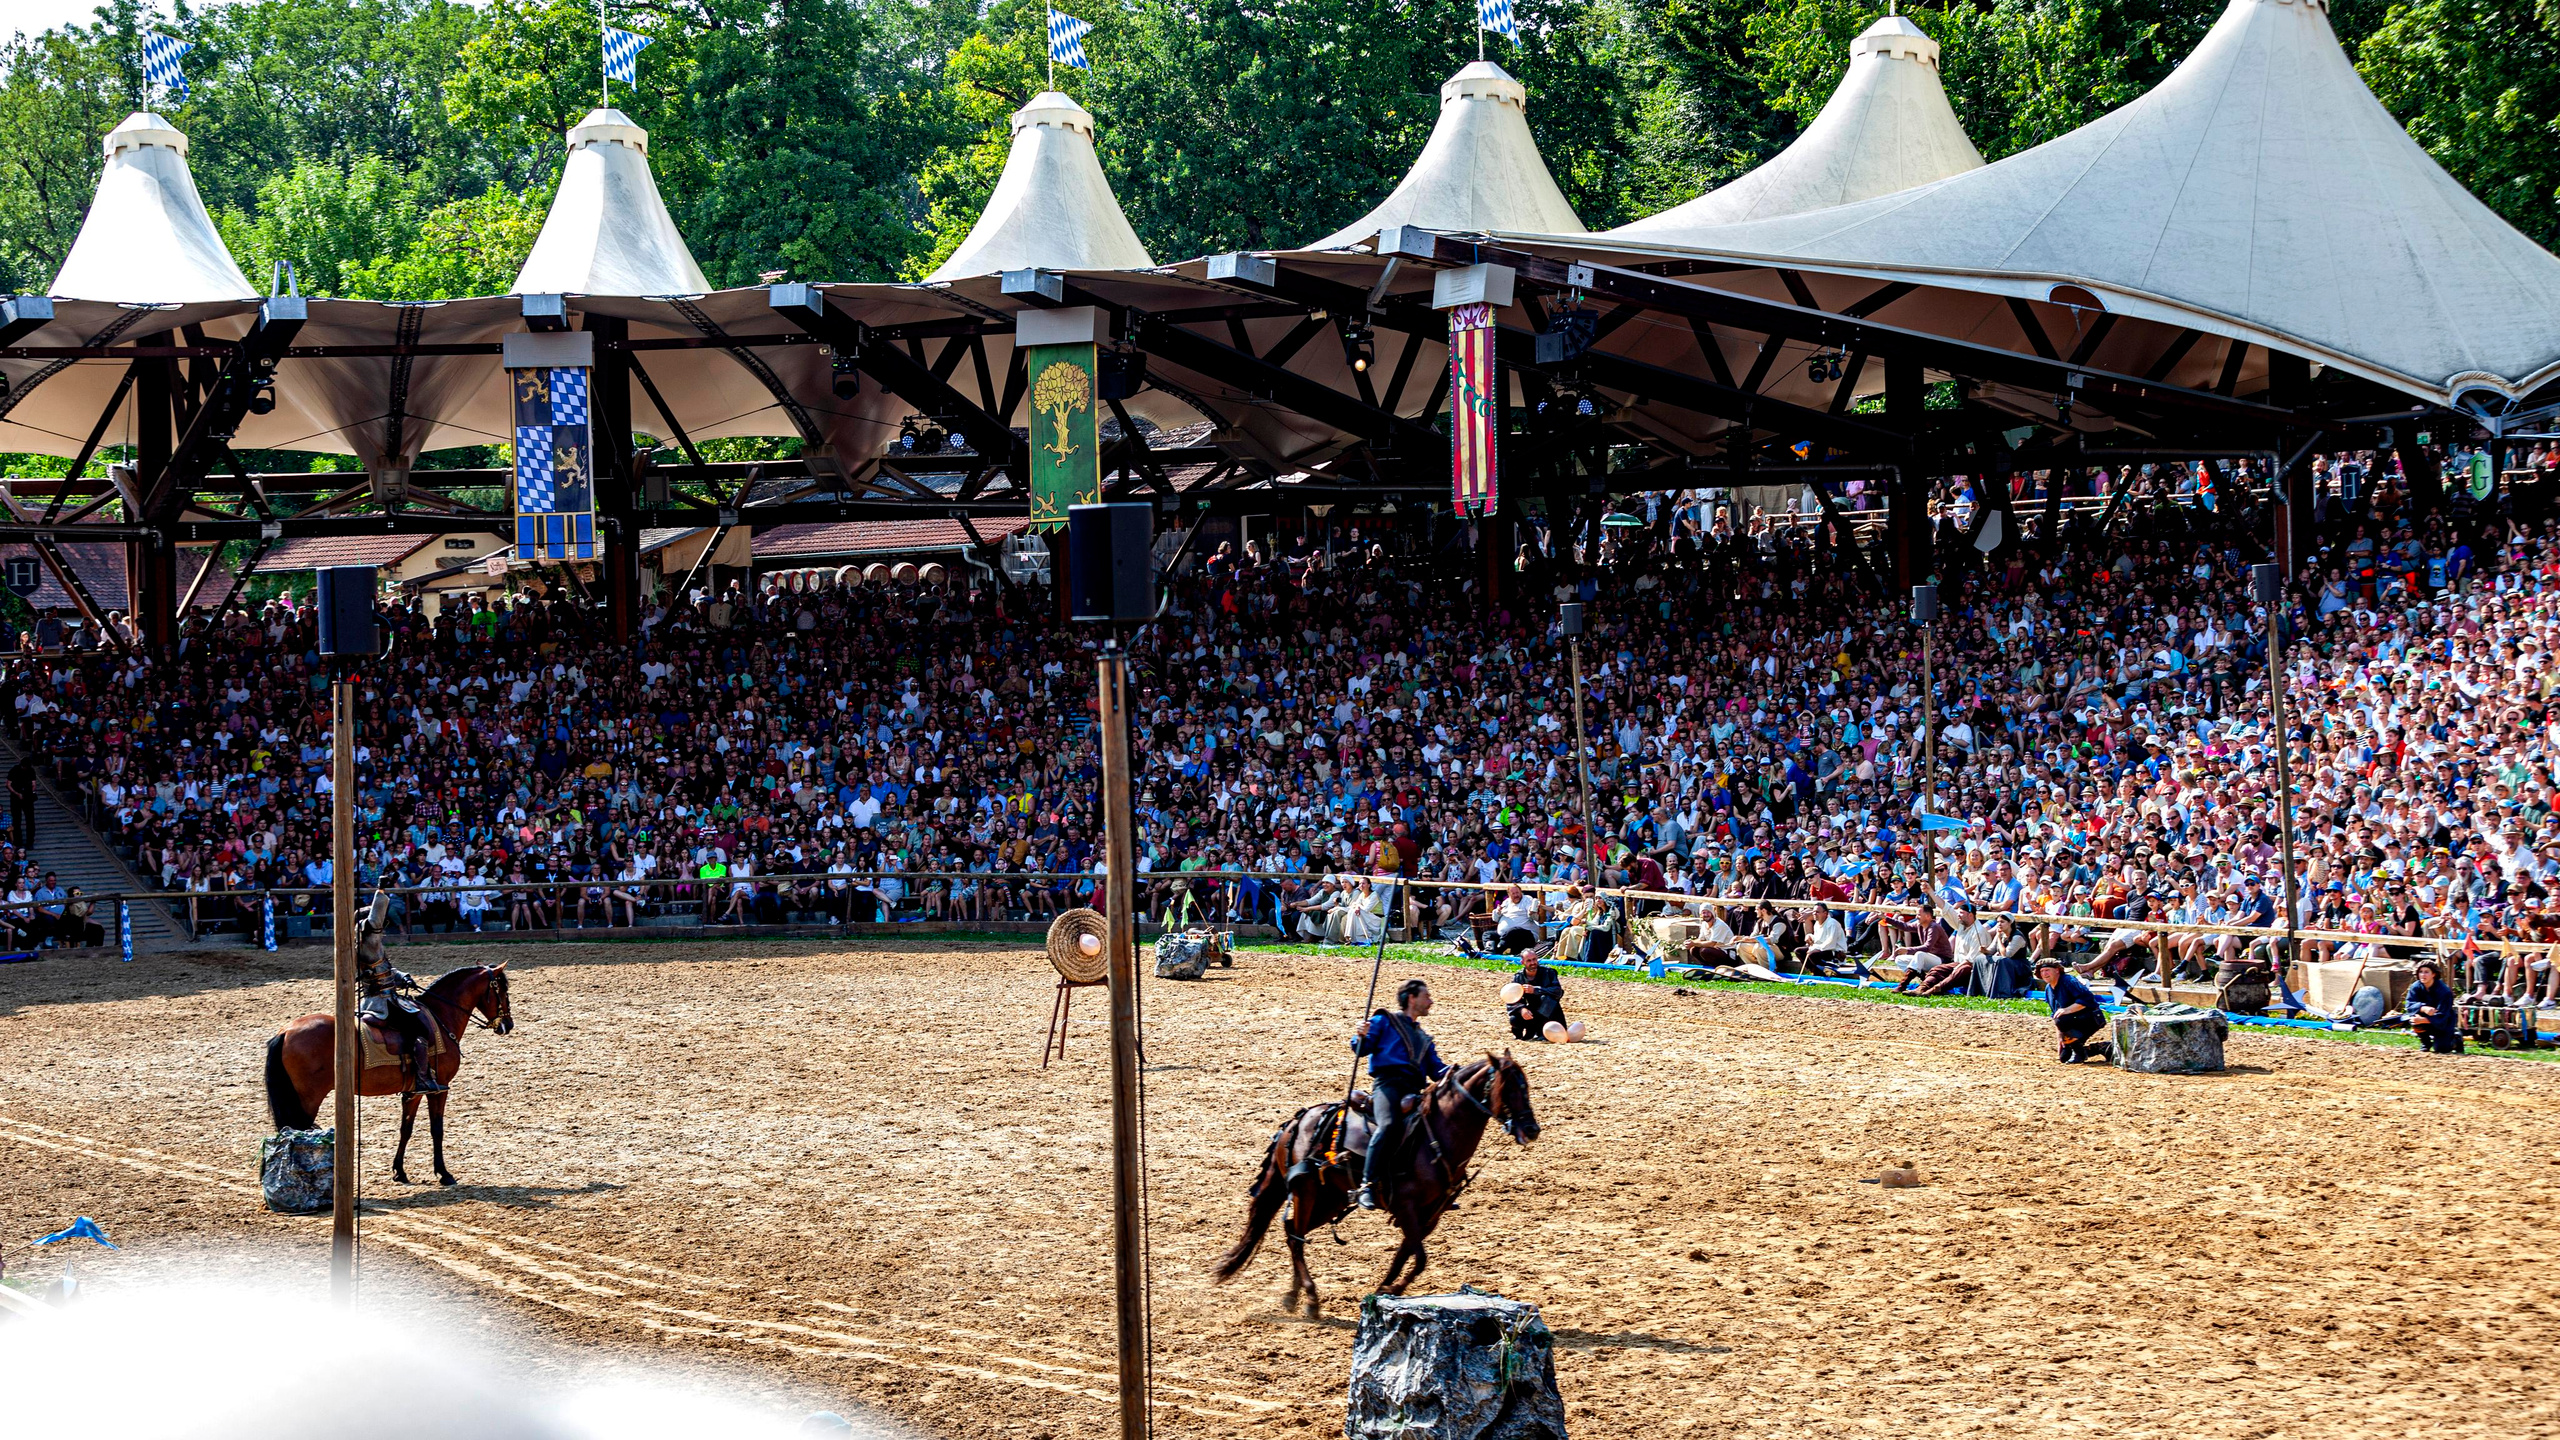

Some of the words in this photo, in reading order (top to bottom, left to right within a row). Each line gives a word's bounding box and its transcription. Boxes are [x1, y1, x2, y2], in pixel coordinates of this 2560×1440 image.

[2341, 472, 2357, 500] H
[2472, 459, 2489, 491] G
[9, 562, 37, 587] H
